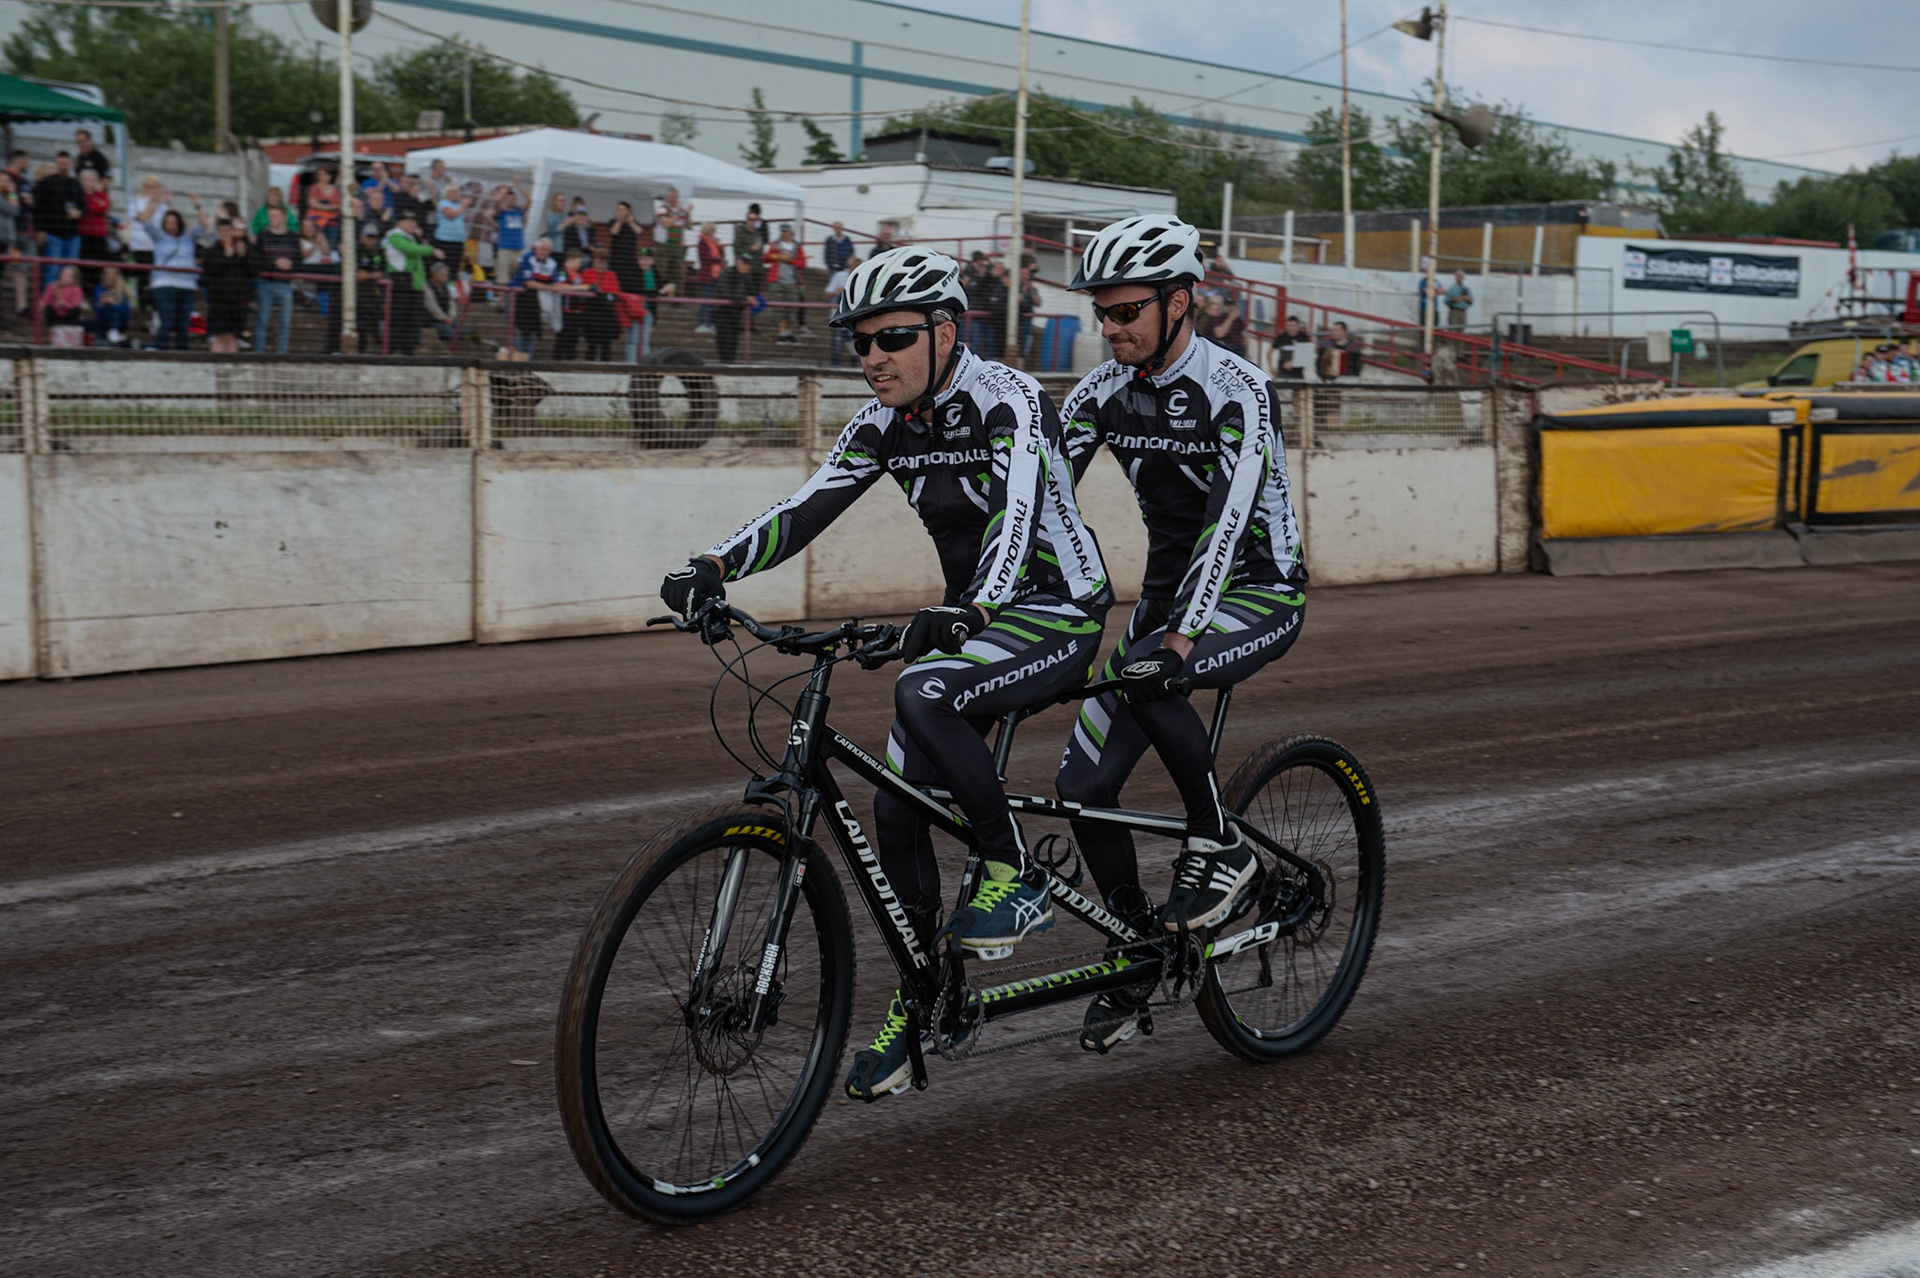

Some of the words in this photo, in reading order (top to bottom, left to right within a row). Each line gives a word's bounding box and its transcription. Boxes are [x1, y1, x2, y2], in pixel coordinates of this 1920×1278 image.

[887, 447, 991, 470] CANNONDALE
[988, 498, 1028, 602] CANNONDALE
[1190, 507, 1241, 630] CANNONDALE
[1194, 611, 1300, 675] CANNONDALE
[953, 639, 1078, 712] CANNONDALE
[834, 734, 884, 772] CANNONDALE
[1334, 759, 1371, 806] MAXXIS
[835, 800, 931, 970] CANNONDALE
[1231, 921, 1279, 955] 29
[755, 942, 779, 995] ROCKSHOX
